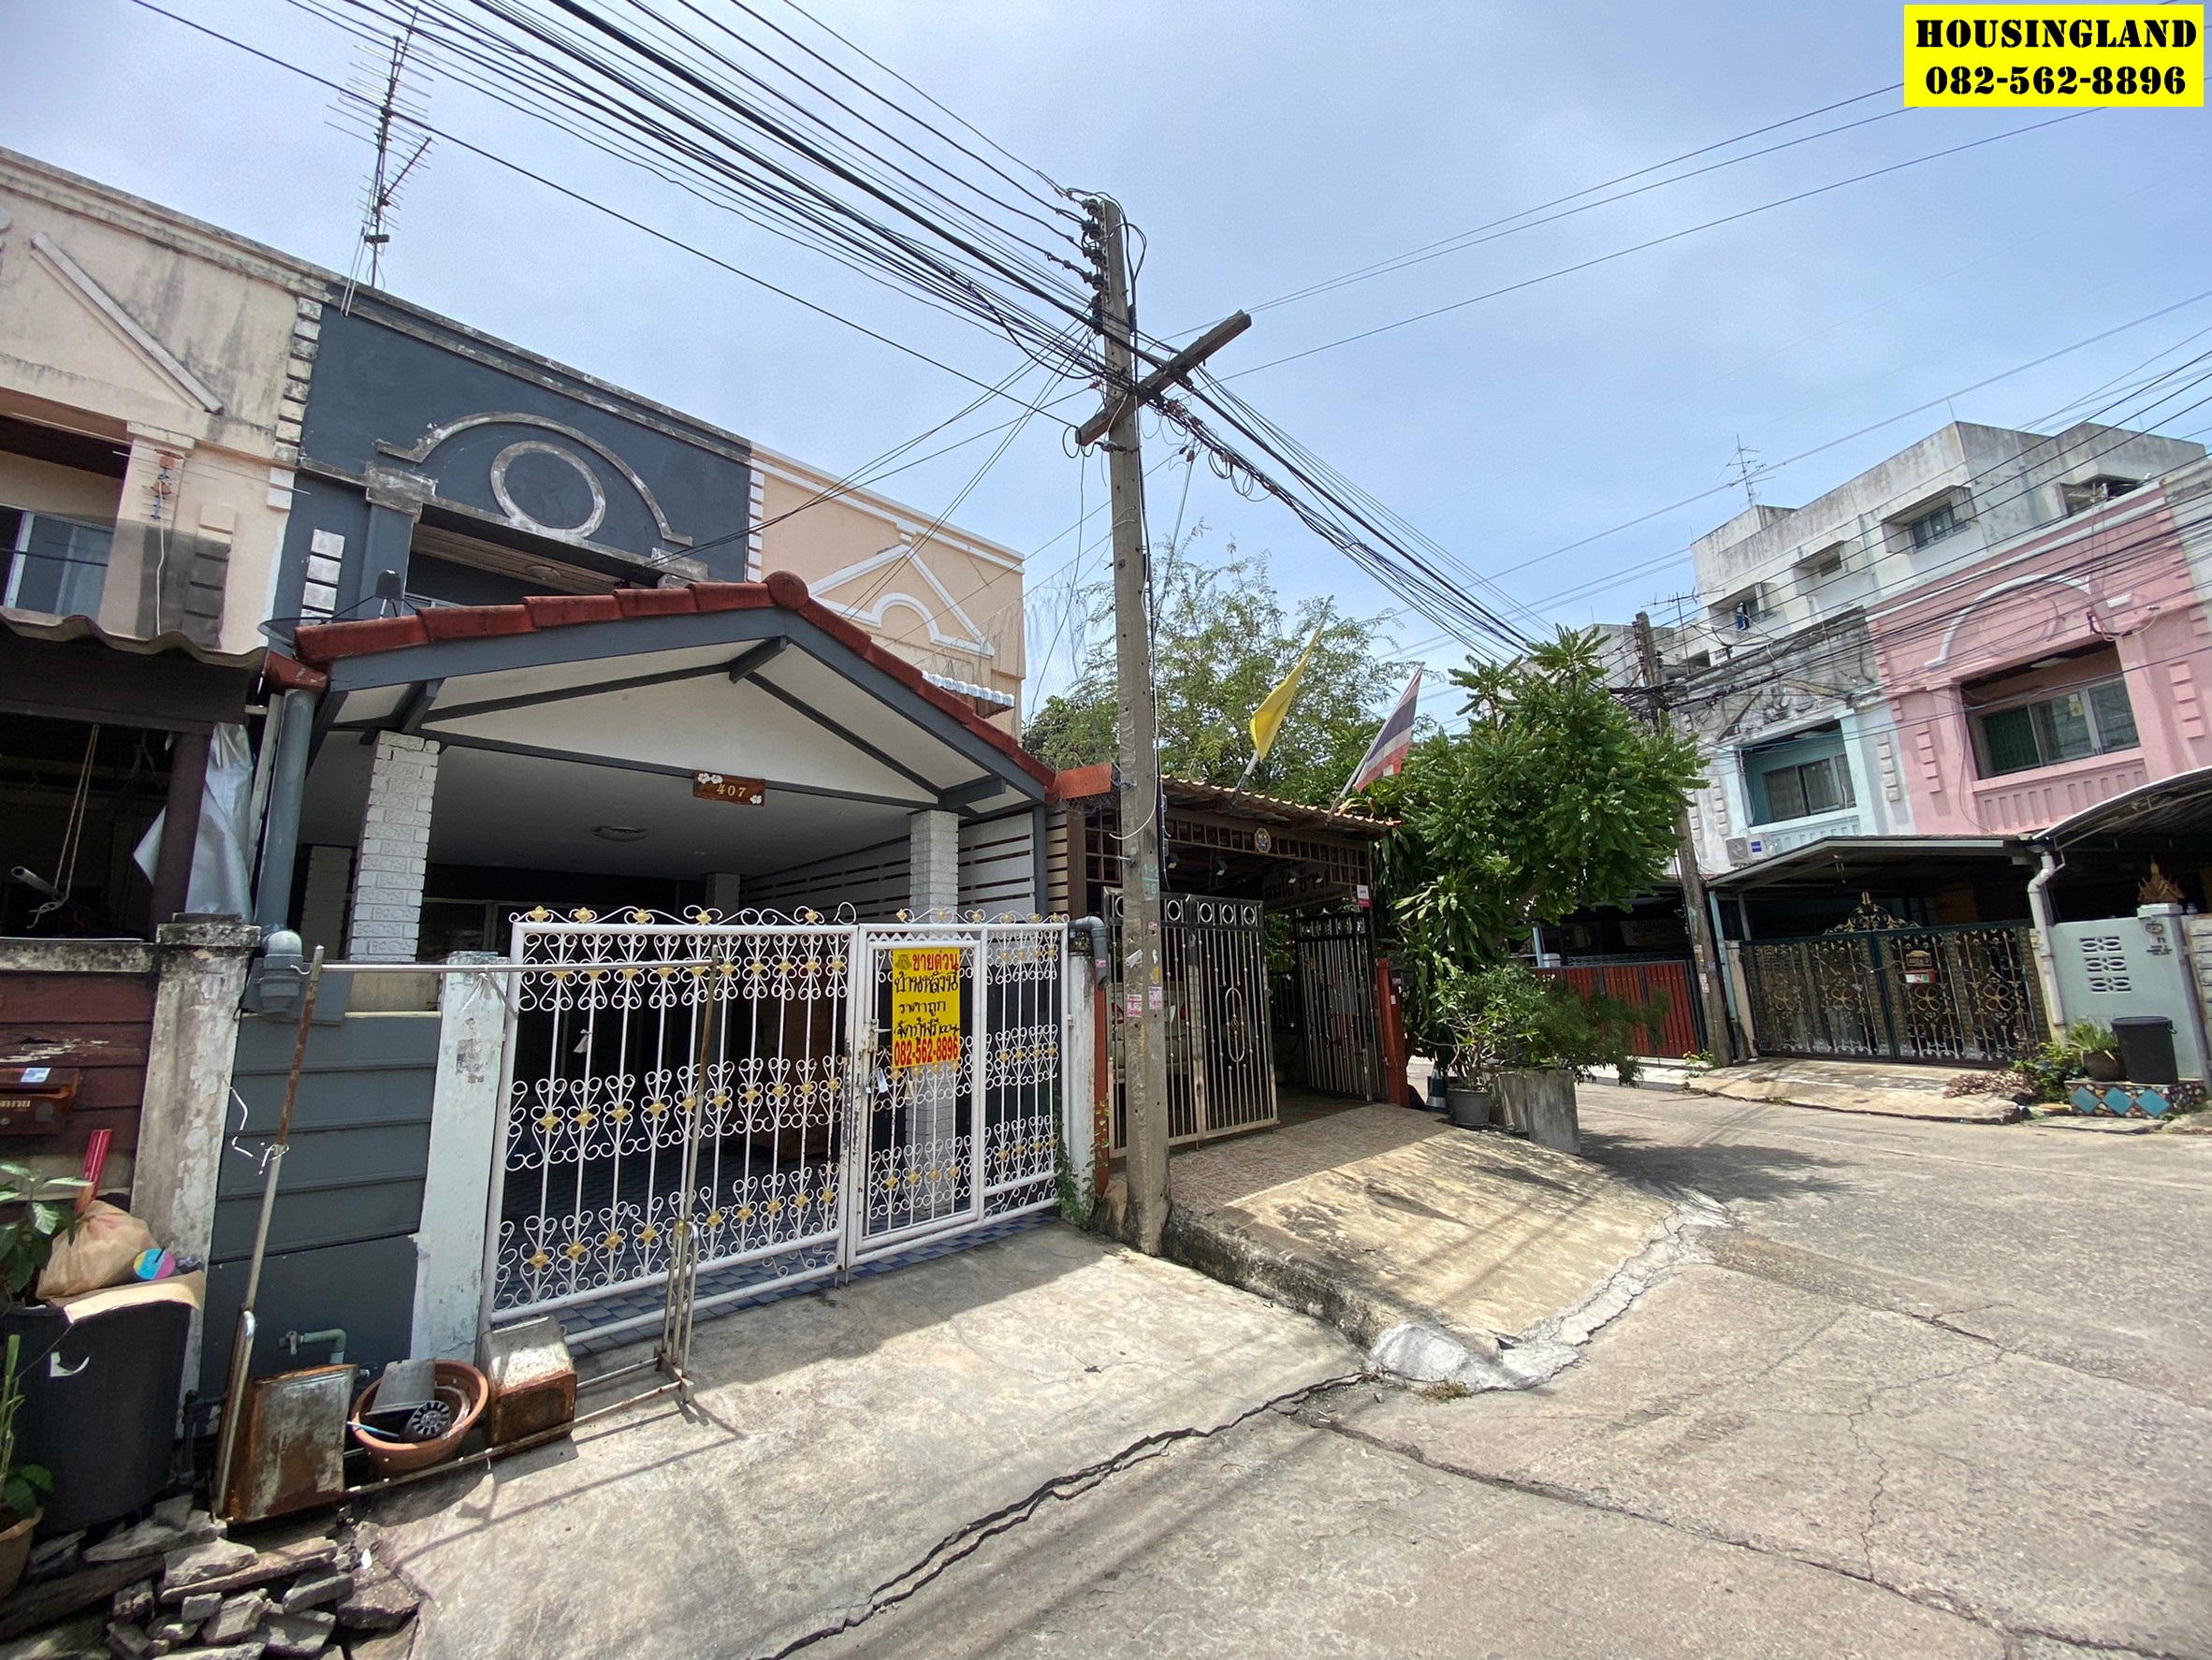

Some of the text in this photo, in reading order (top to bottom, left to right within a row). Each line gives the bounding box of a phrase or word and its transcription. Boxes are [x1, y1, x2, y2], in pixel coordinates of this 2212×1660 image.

[716, 783, 747, 797] 407
[912, 950, 959, 971] ขายด่วน
[894, 970, 959, 994] บ้านหลังนี้
[894, 1035, 959, 1067] 082-562-8896
